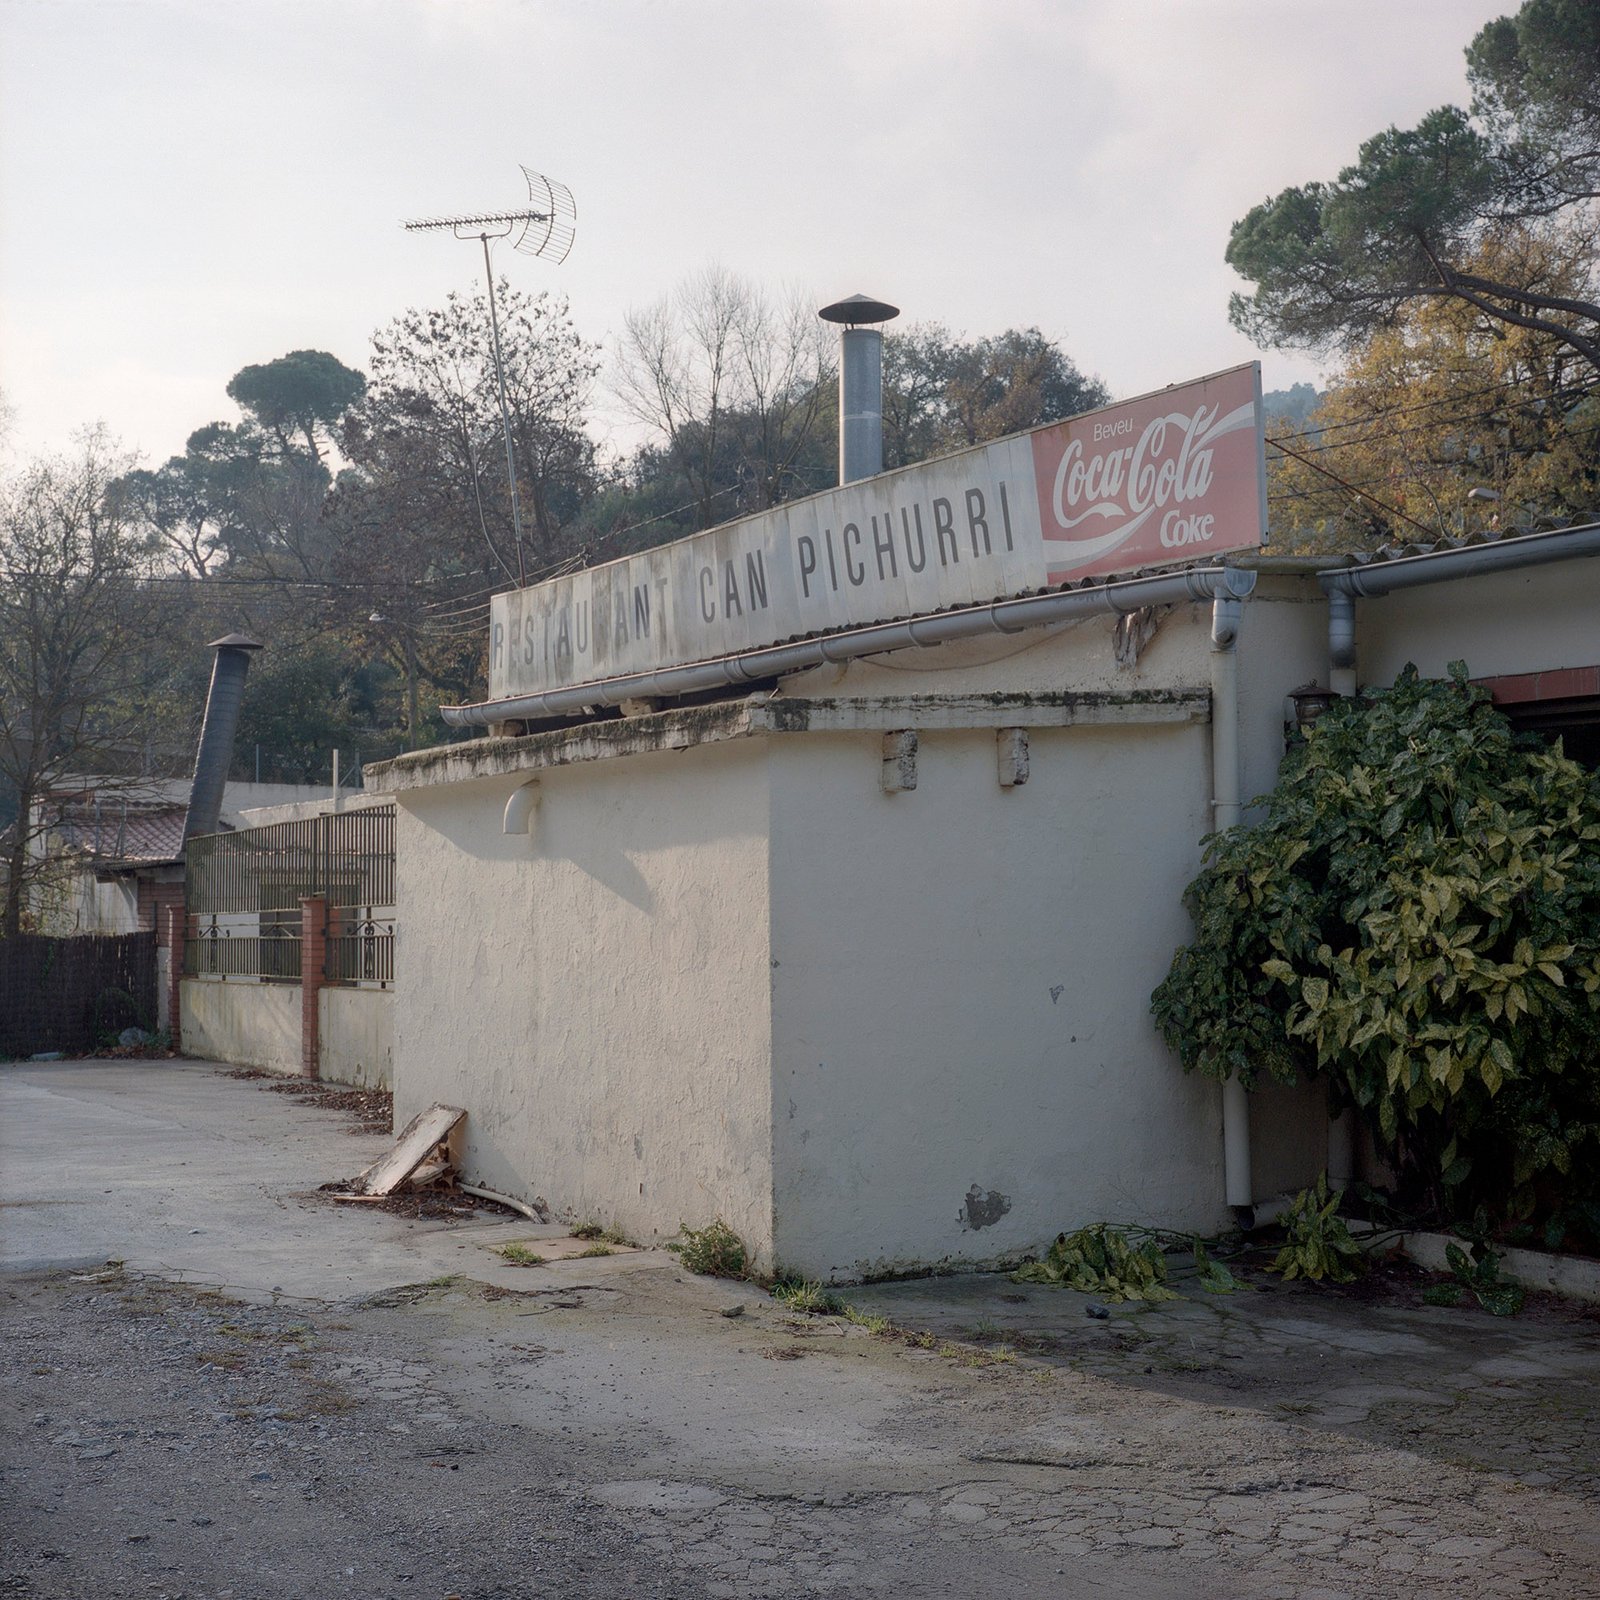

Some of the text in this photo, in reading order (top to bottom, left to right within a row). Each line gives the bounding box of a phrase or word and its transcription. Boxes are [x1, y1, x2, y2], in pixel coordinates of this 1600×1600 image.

[1053, 401, 1219, 529] Coca-Cola
[1093, 418, 1133, 442] Beveu
[700, 549, 767, 624] CAN
[798, 481, 1013, 598] PICHURRI
[1160, 509, 1215, 548] Coke
